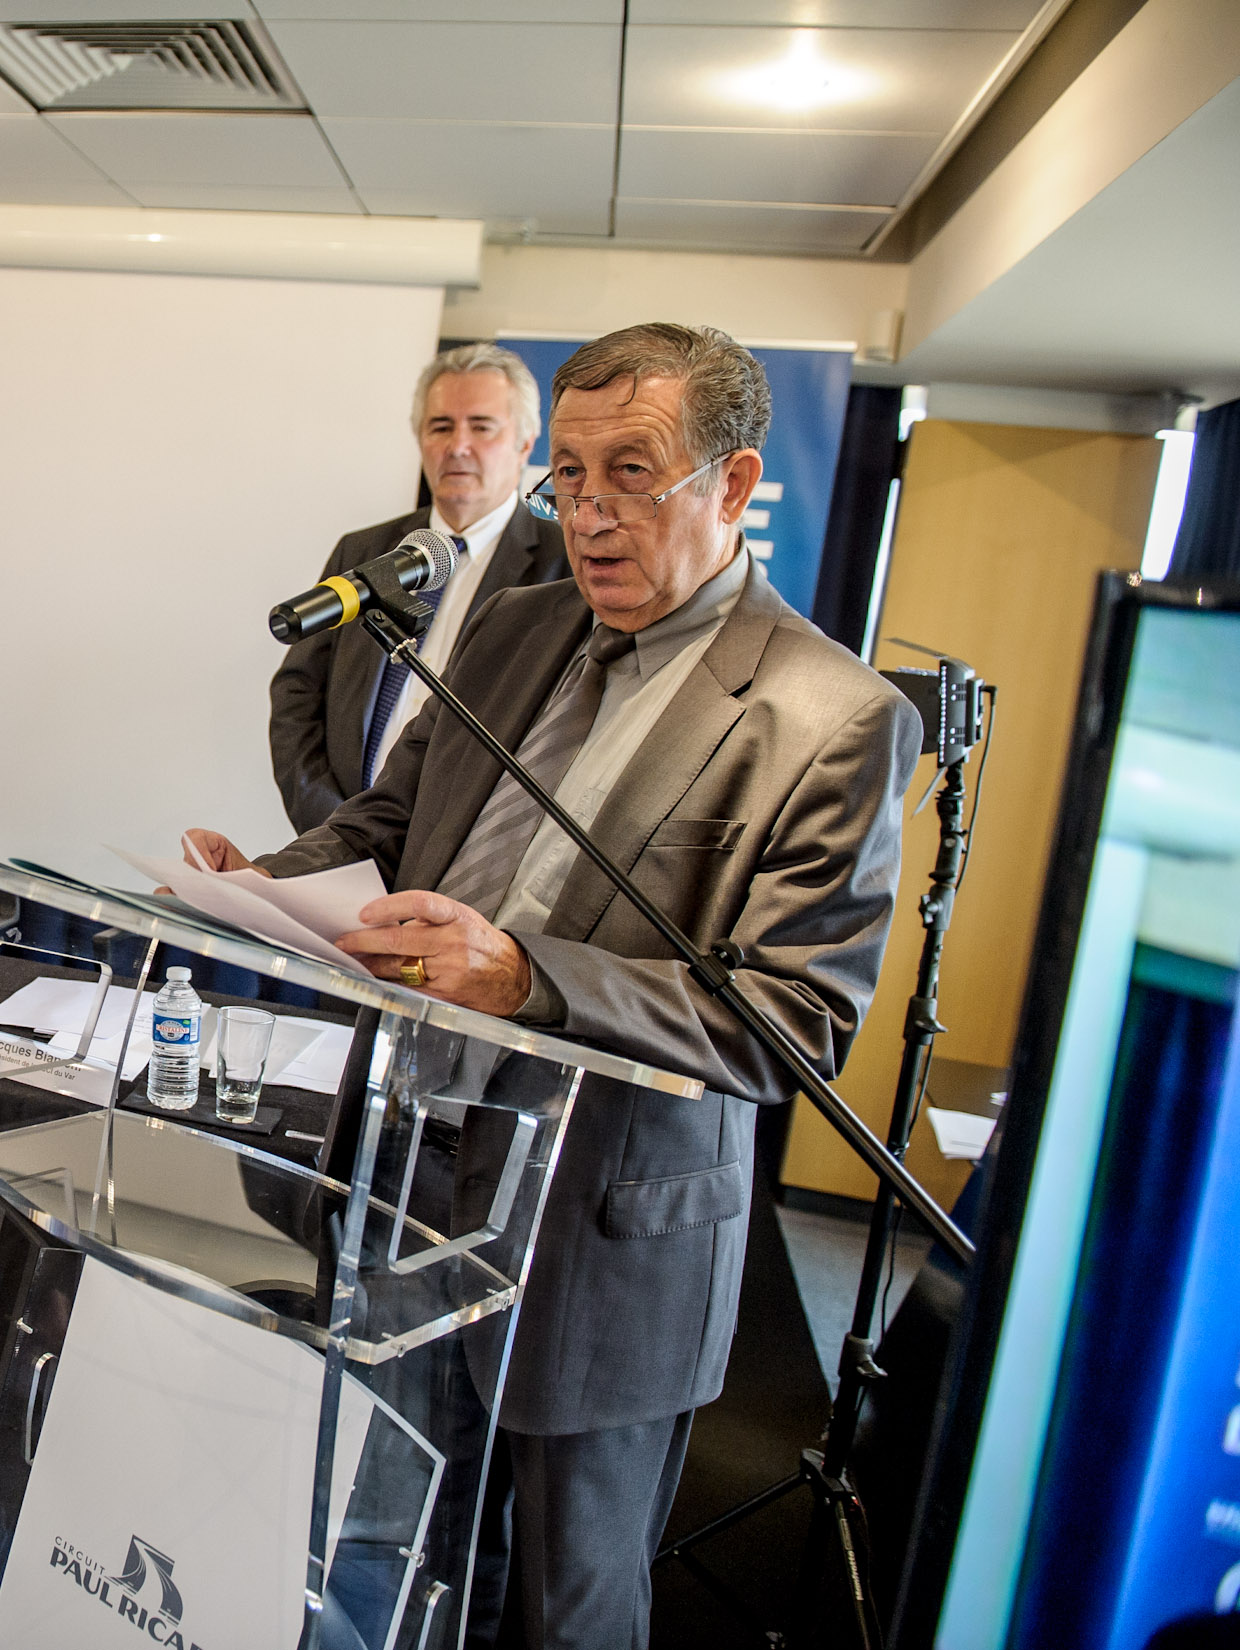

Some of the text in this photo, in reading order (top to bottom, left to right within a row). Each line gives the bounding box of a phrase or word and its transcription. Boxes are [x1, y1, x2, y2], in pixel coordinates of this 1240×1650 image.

[21, 1058, 30, 1067] de
[54, 1069, 63, 1078] du
[64, 1071, 76, 1081] Var
[55, 1536, 106, 1574] CIRCUIT
[49, 1546, 113, 1608] PAUL
